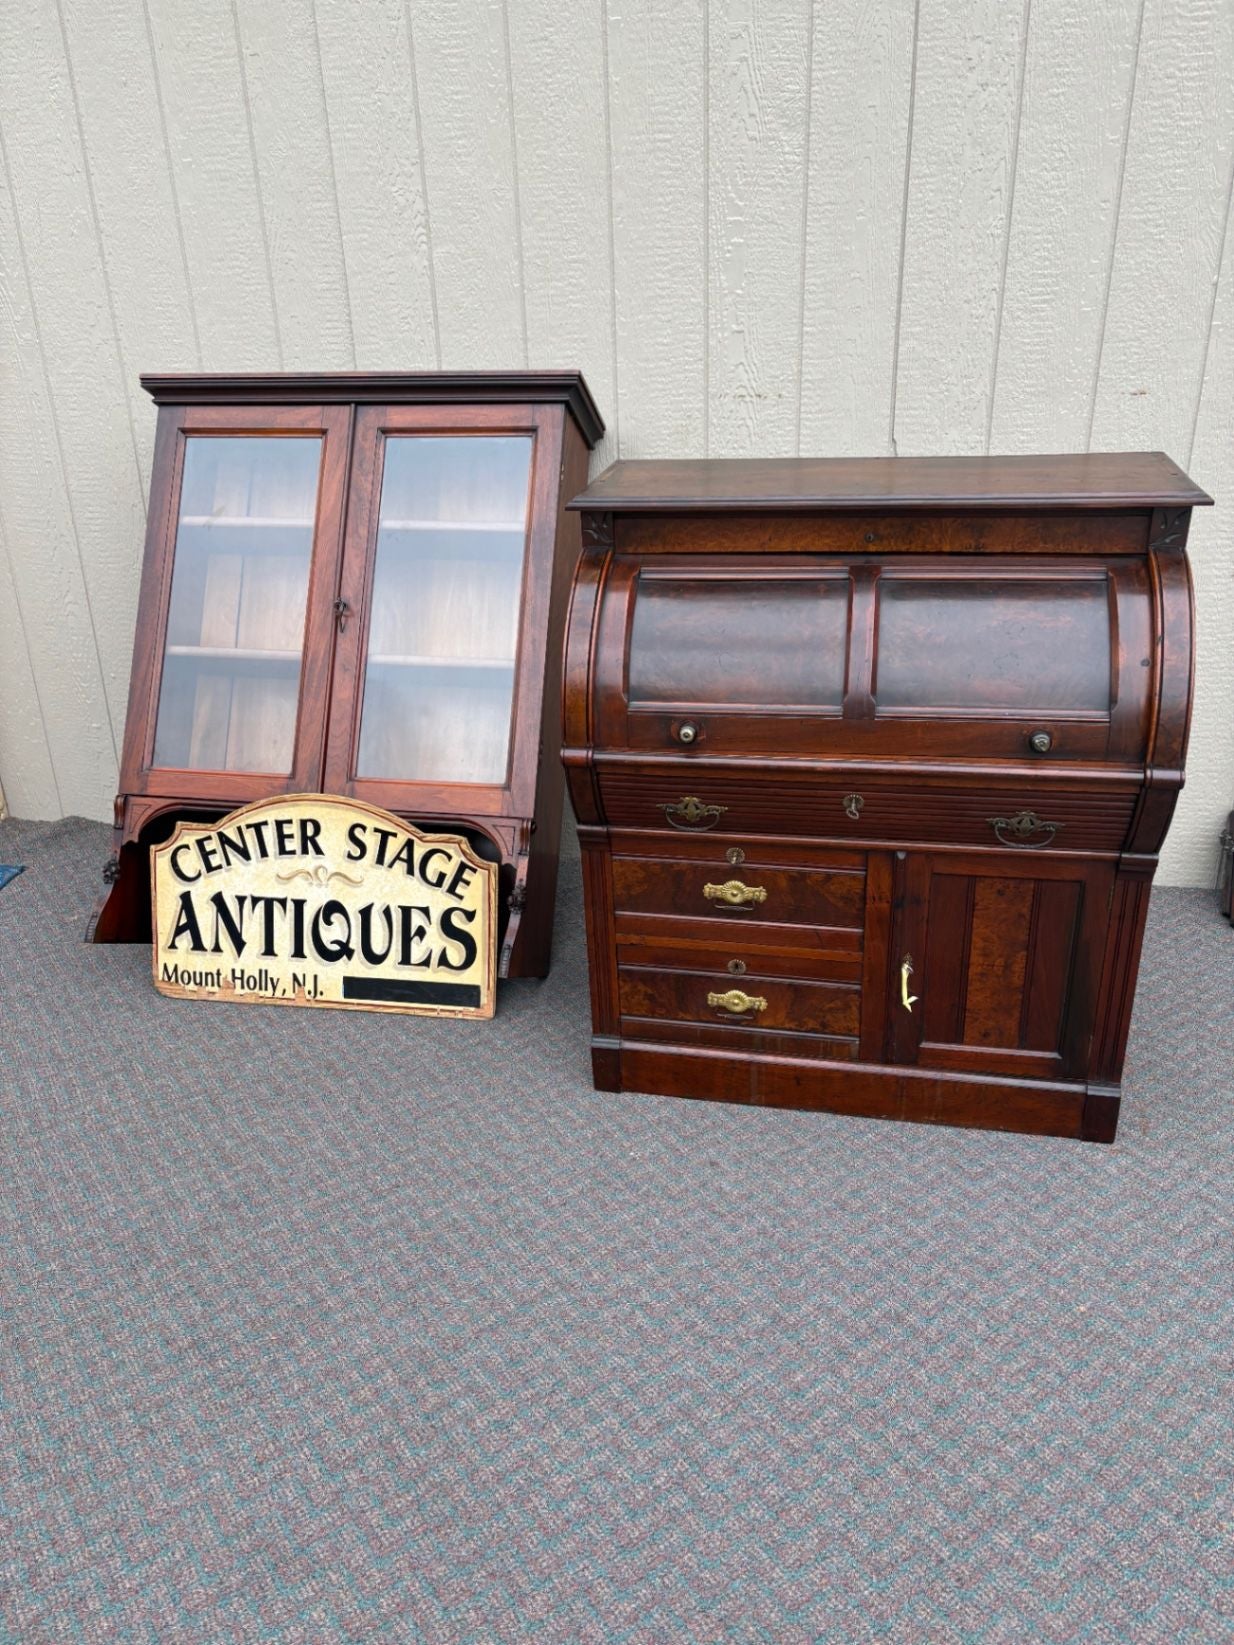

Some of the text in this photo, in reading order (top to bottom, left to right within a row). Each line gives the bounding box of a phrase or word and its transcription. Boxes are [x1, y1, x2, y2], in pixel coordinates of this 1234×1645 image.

[171, 818, 478, 900] CENTER STAGE
[168, 890, 478, 971] ANTIQUES
[162, 962, 324, 999] Mount Holly, N.J.
